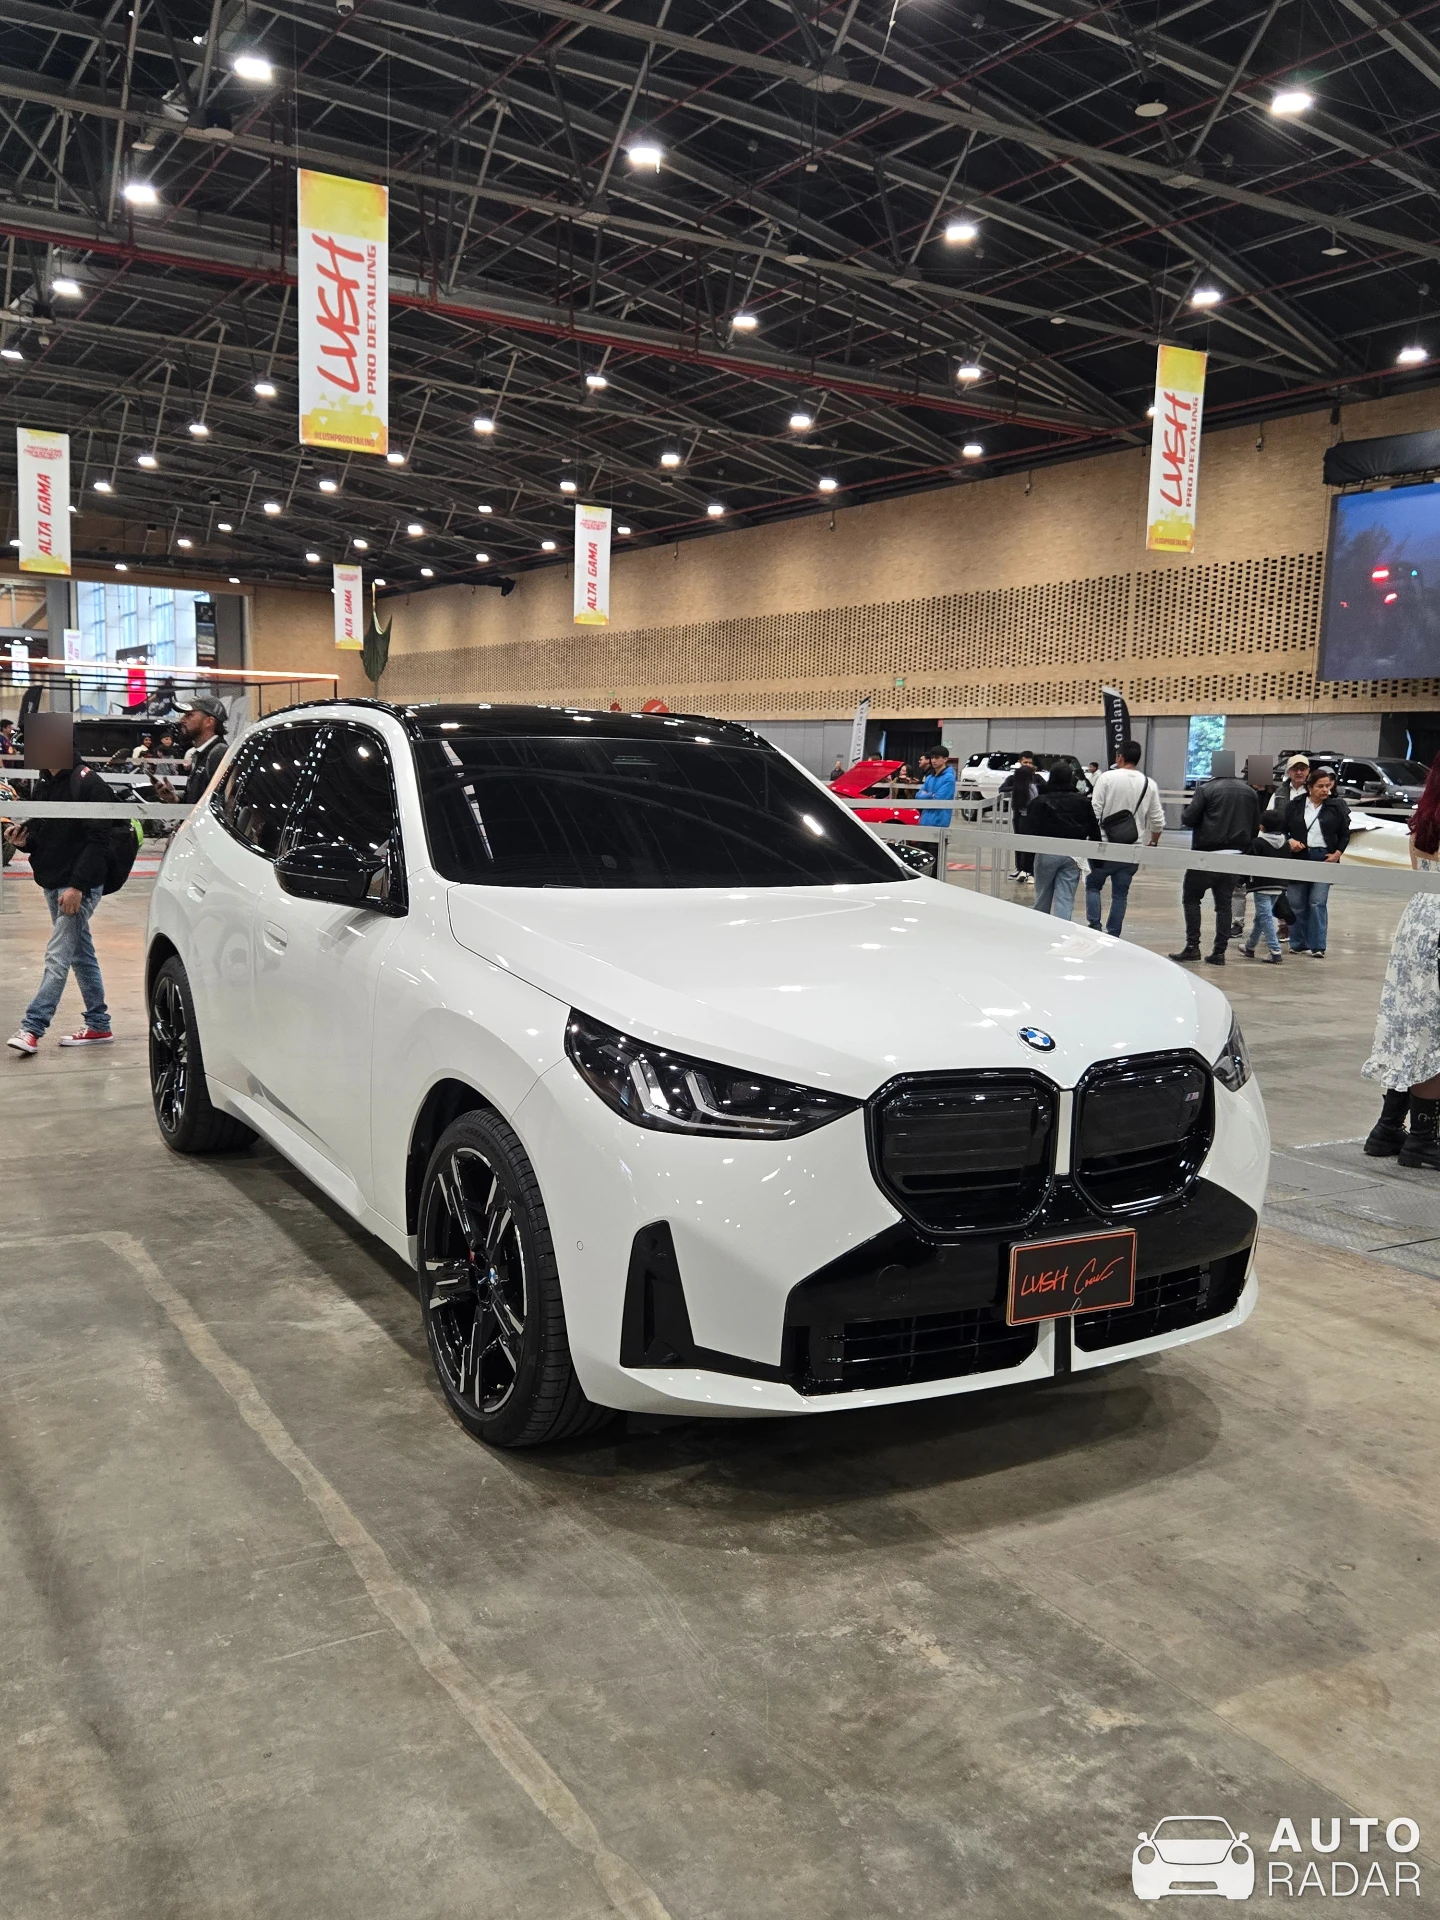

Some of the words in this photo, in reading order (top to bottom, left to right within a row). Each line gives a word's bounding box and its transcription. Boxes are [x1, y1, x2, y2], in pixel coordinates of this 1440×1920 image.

[311, 232, 365, 393] LUSH
[366, 244, 377, 349] DETAILING
[366, 353, 377, 395] PRO
[1160, 391, 1191, 507] LUSH
[1187, 397, 1199, 471] DETAILING
[37, 472, 52, 516] GAMA
[1185, 477, 1194, 508] PRO
[37, 520, 52, 556] ALTA
[587, 541, 598, 577] GAMA
[344, 589, 353, 615] GAMA
[587, 581, 597, 611] ALTA
[344, 617, 354, 640] ALTA
[1020, 1265, 1069, 1297] LUSH
